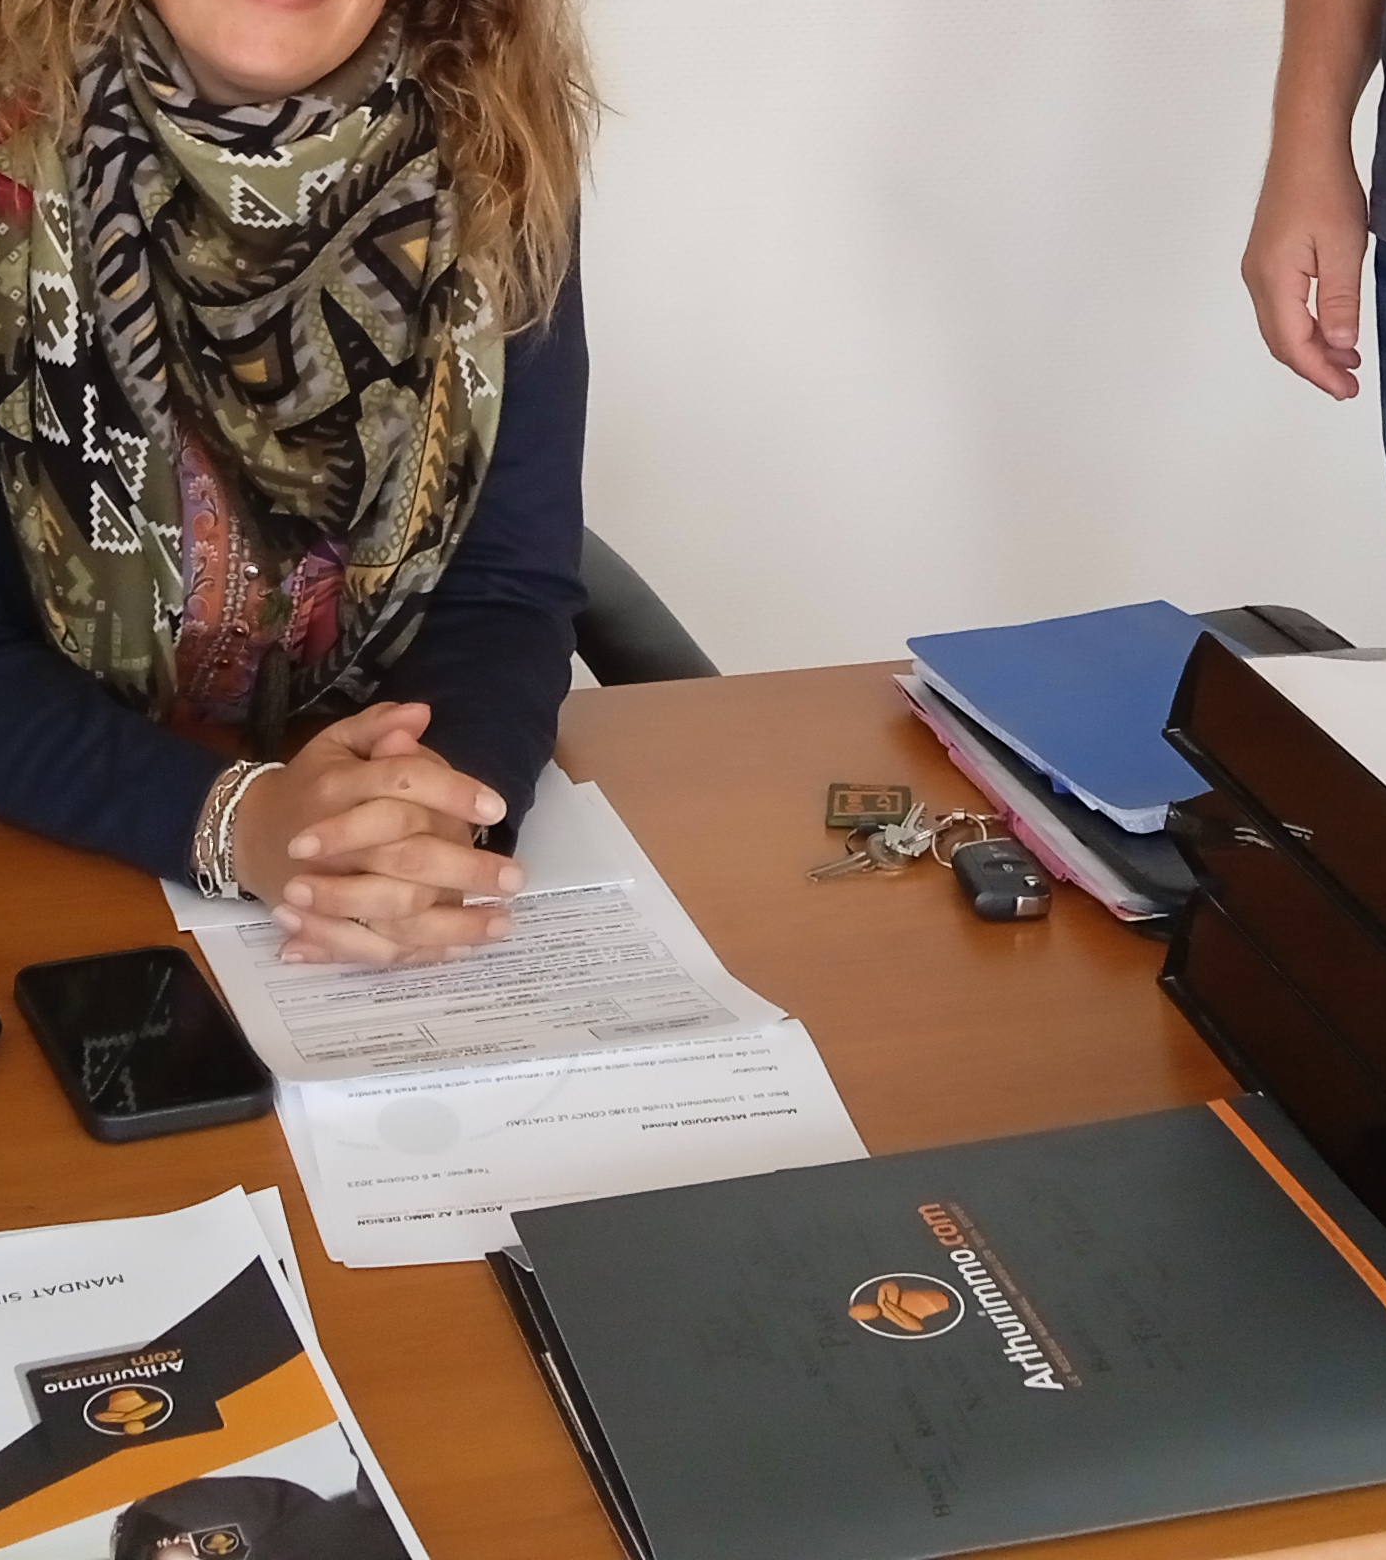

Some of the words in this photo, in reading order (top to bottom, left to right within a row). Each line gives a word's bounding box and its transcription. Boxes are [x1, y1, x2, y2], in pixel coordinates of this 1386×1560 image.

[571, 1109, 606, 1121] COUCY
[749, 1107, 798, 1118] Monsieur
[347, 1178, 374, 1189] 2023
[375, 1175, 420, 1186] Octobre
[437, 1210, 453, 1219] AZ
[456, 1205, 504, 1218] AGENCE
[357, 1215, 401, 1227] DESIGN
[403, 1213, 435, 1223] IMMO
[31, 1273, 125, 1301] MANDAT
[917, 1203, 1065, 1391] Arthurimmo.com
[130, 1349, 182, 1367] .com
[43, 1359, 184, 1395] Arthurimmo
